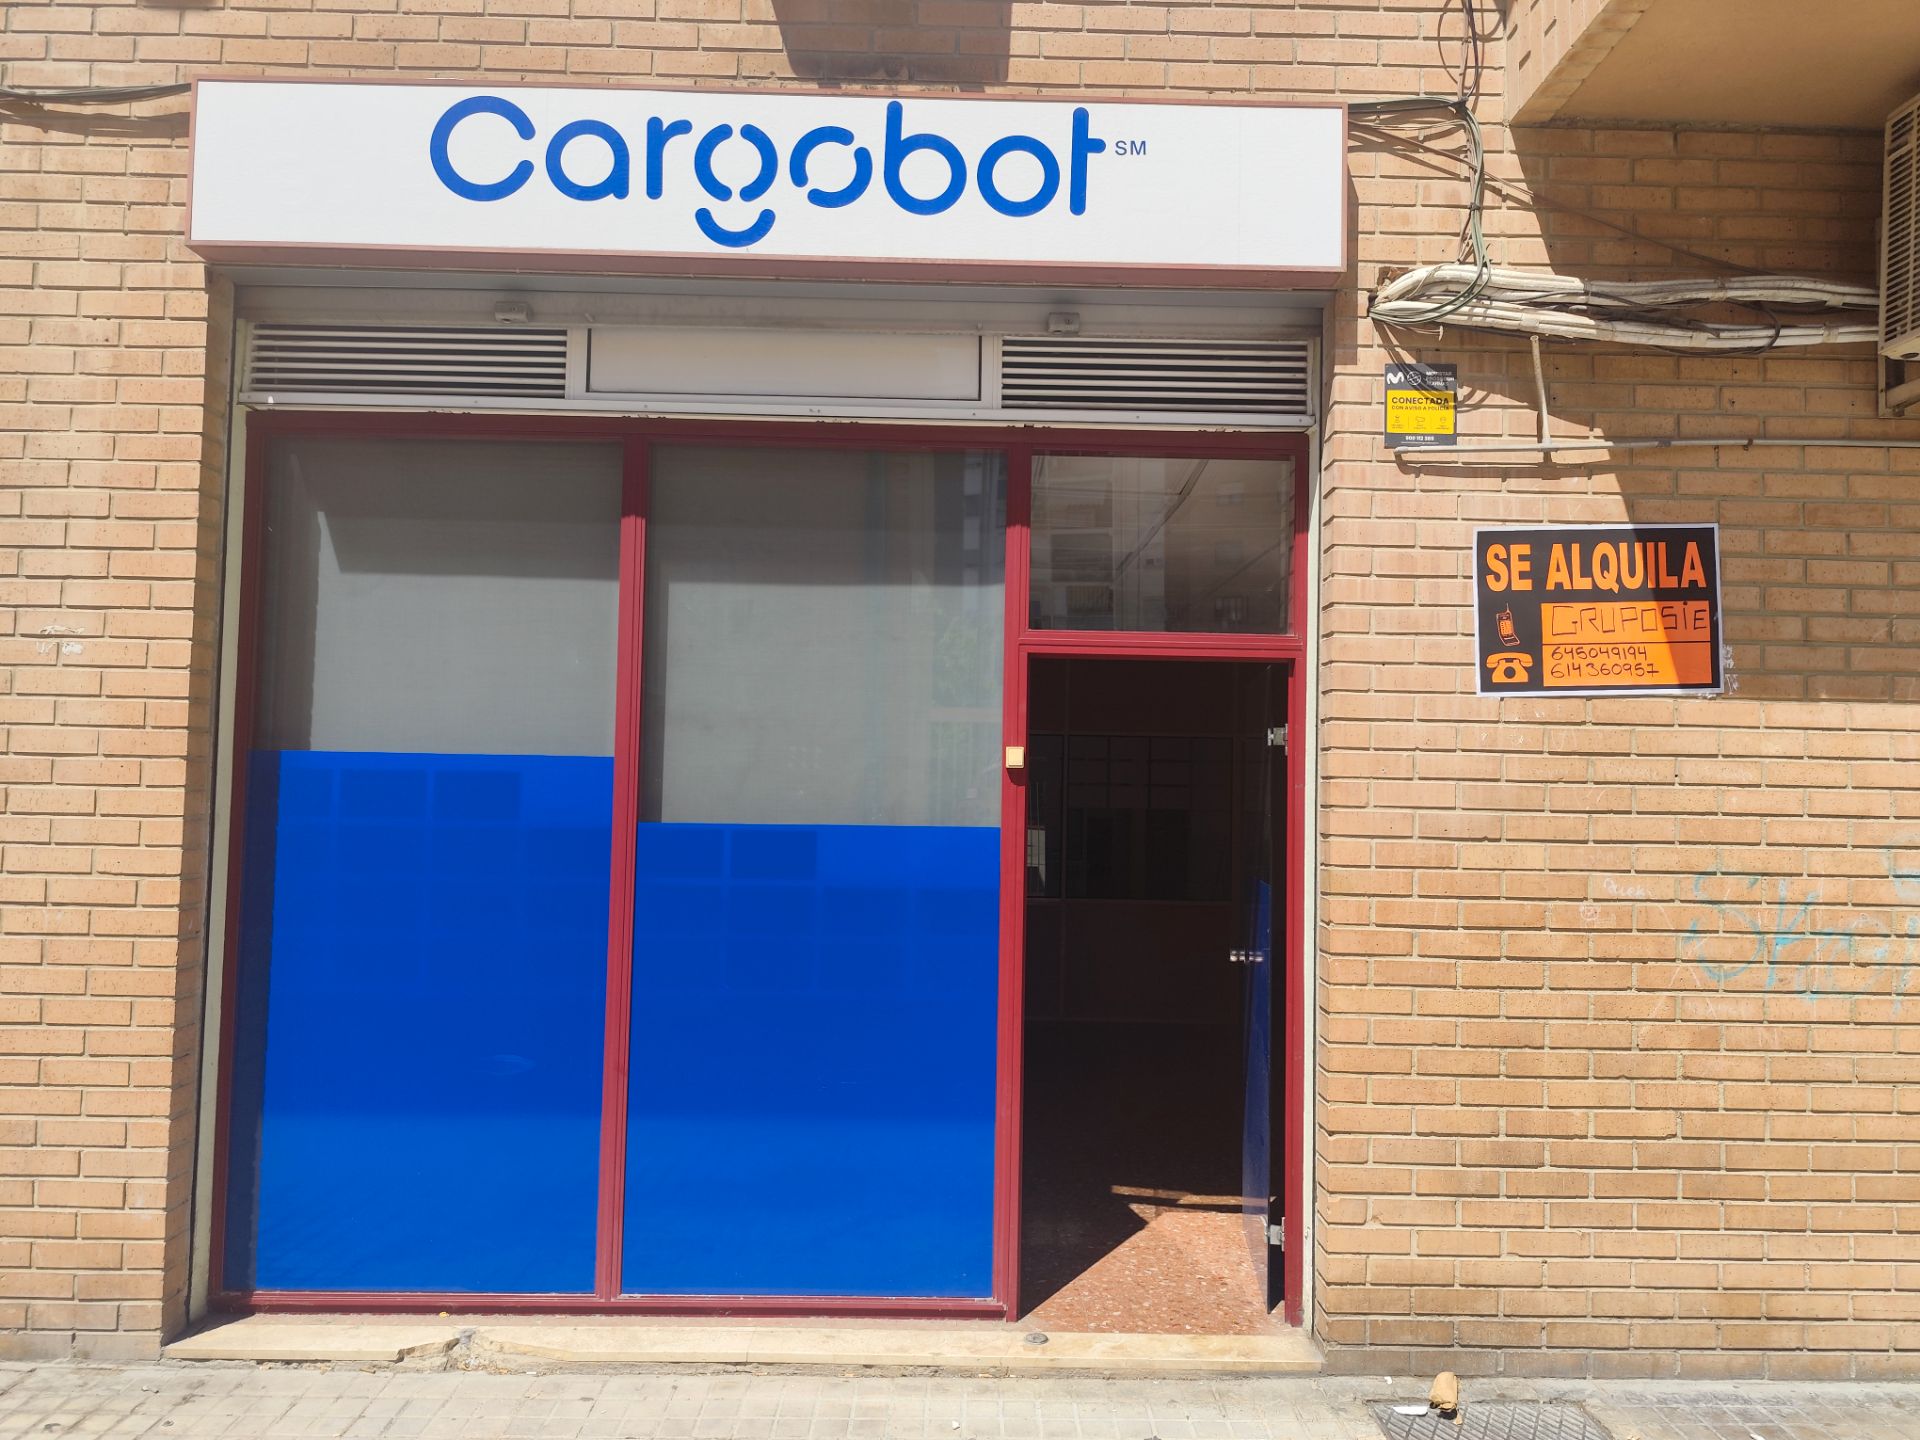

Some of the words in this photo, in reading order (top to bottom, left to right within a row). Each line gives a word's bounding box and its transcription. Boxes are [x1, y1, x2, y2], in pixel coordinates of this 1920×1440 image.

[430, 95, 1106, 248] Cargobot
[1114, 140, 1147, 156] SM
[1391, 397, 1449, 405] CONECTADA
[1486, 543, 1533, 592] SE
[1546, 541, 1707, 594] ALQUILA
[1551, 645, 1648, 661] 645049194
